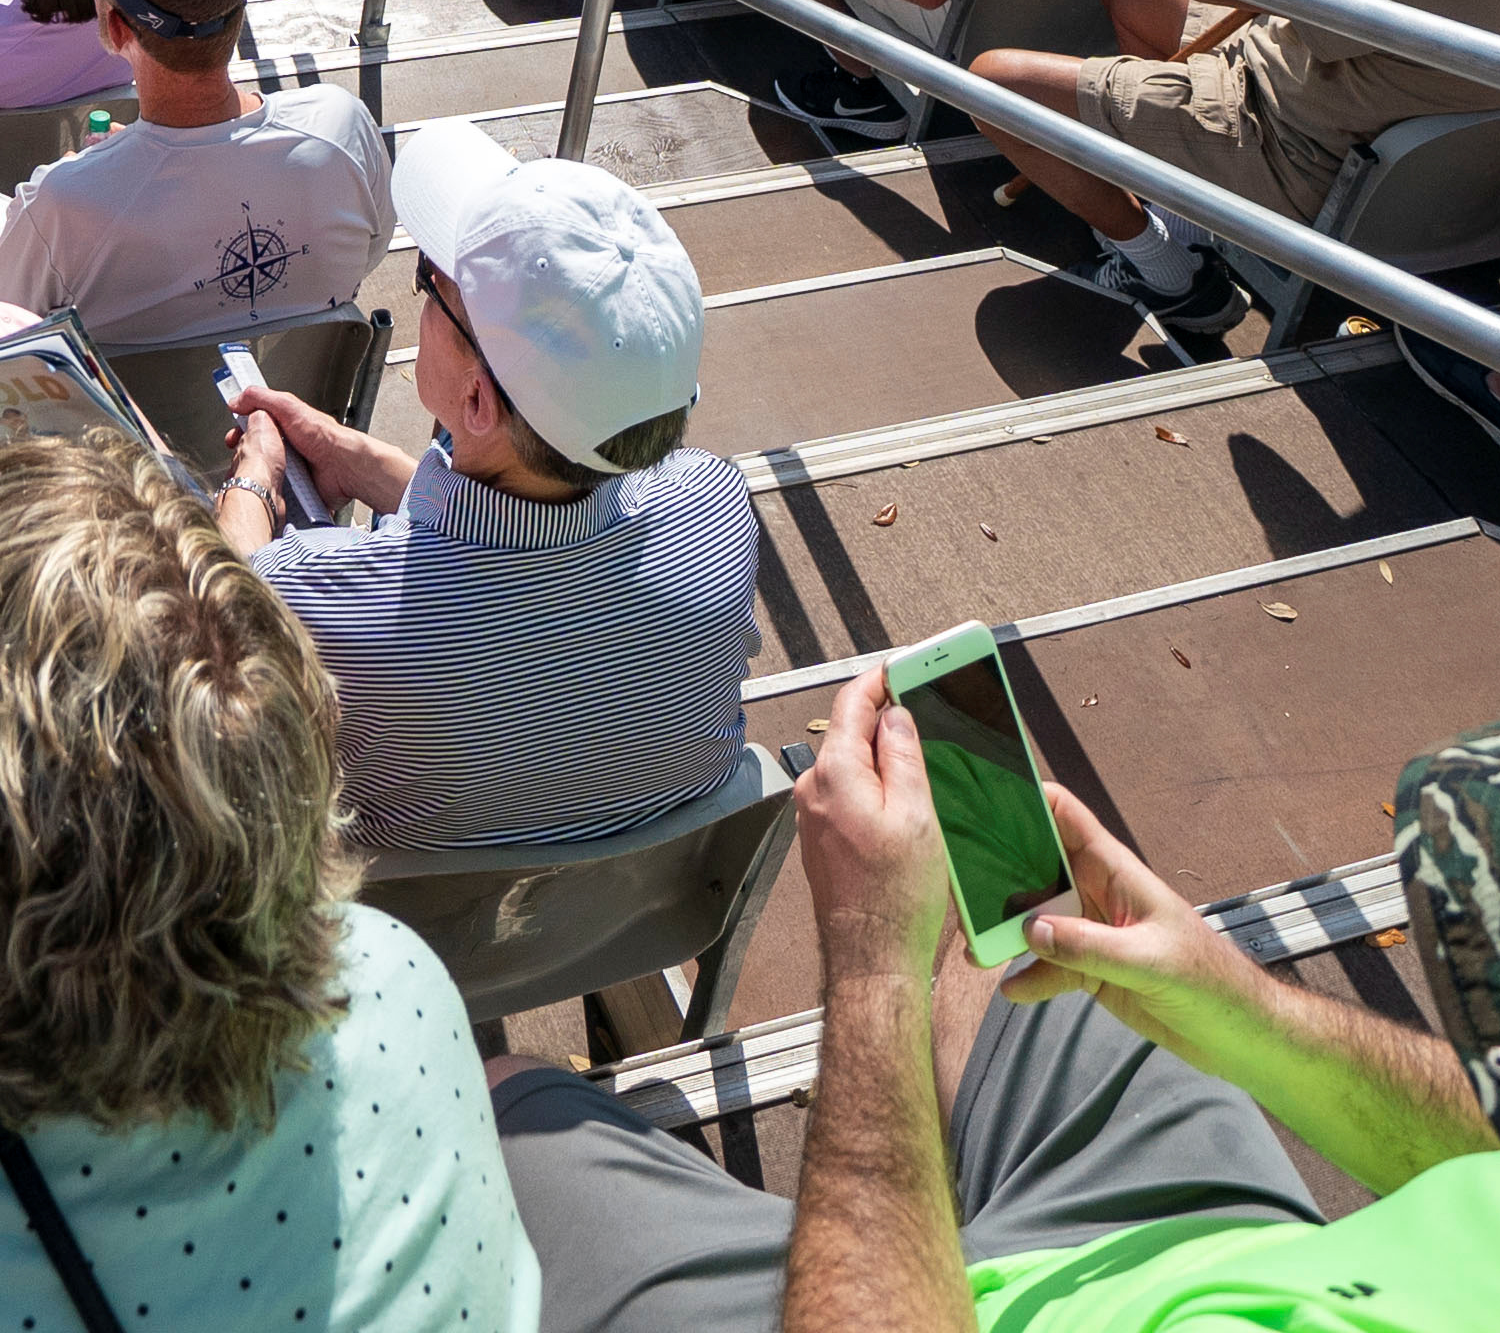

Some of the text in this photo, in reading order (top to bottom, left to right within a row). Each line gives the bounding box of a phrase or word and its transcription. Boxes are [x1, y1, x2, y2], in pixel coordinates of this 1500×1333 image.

[241, 200, 251, 214] N
[302, 243, 311, 255] E
[193, 278, 207, 291] W
[249, 310, 259, 322] S
